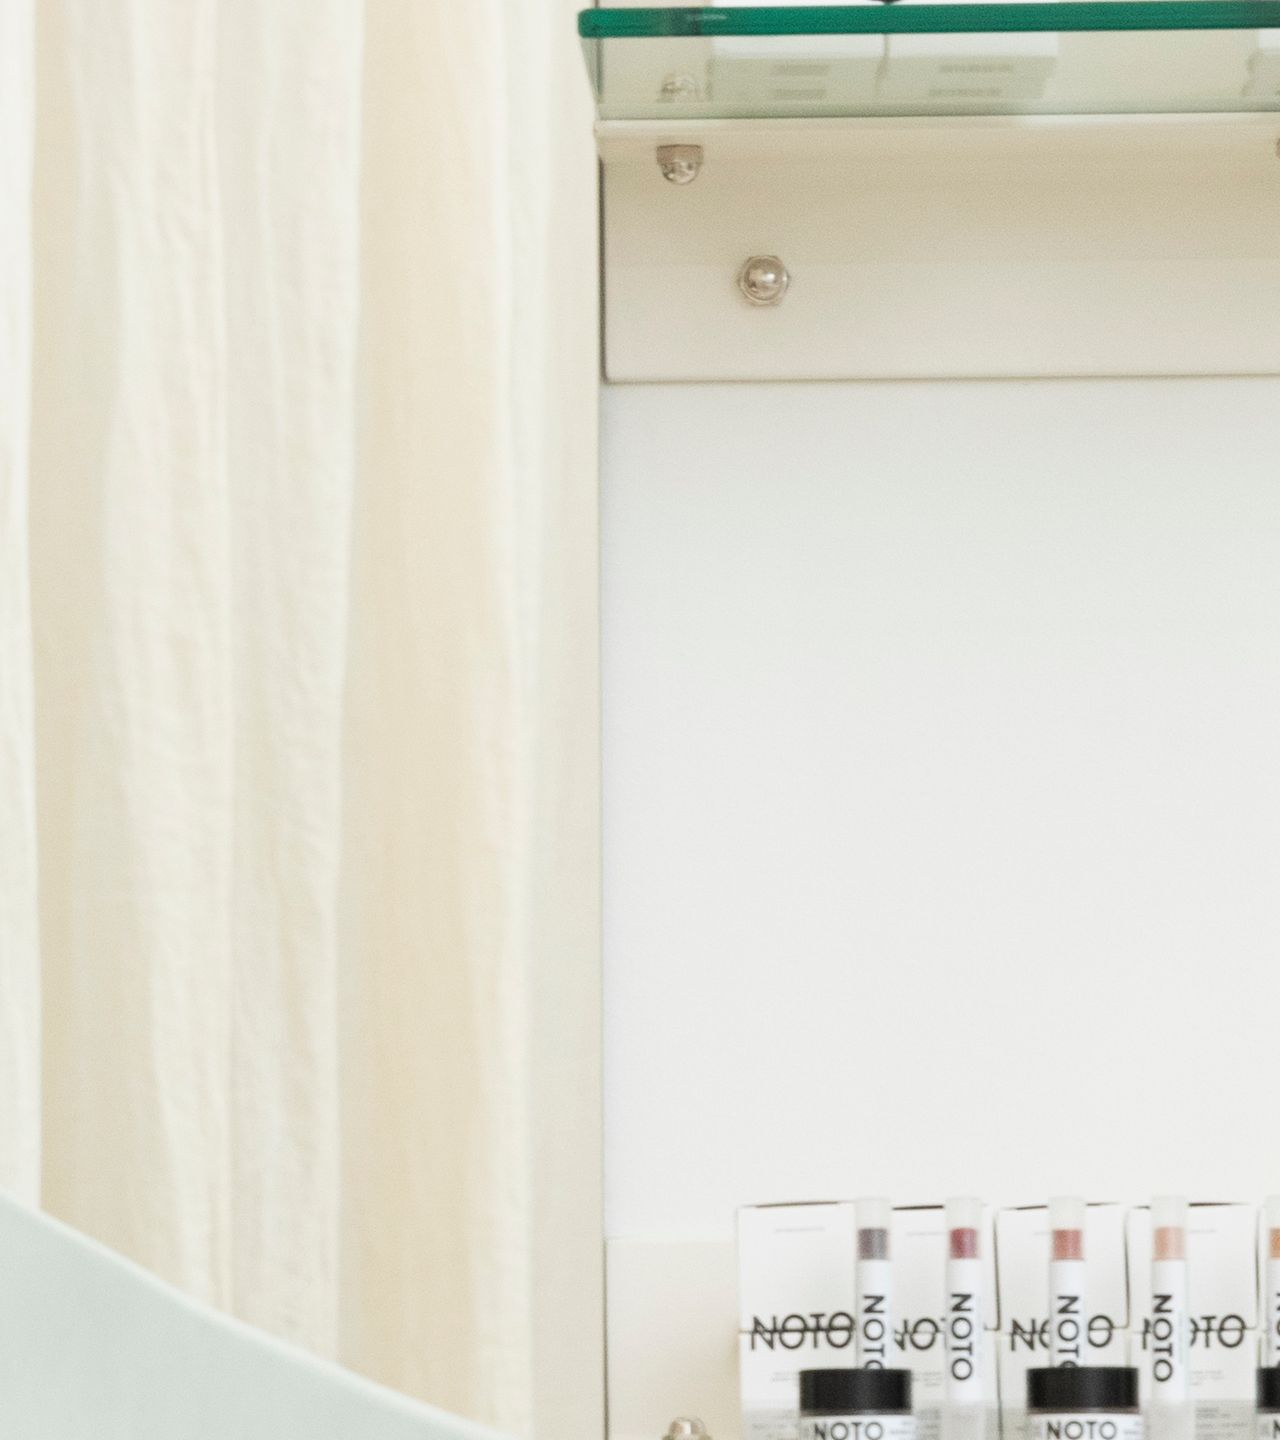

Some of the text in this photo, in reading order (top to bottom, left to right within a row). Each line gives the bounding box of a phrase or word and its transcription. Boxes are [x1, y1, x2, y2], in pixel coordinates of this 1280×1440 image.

[750, 1311, 855, 1350] NOTO
[951, 1293, 973, 1380] NOTO
[1153, 1294, 1173, 1382] NOTO
[1046, 1420, 1117, 1440] NOTO
